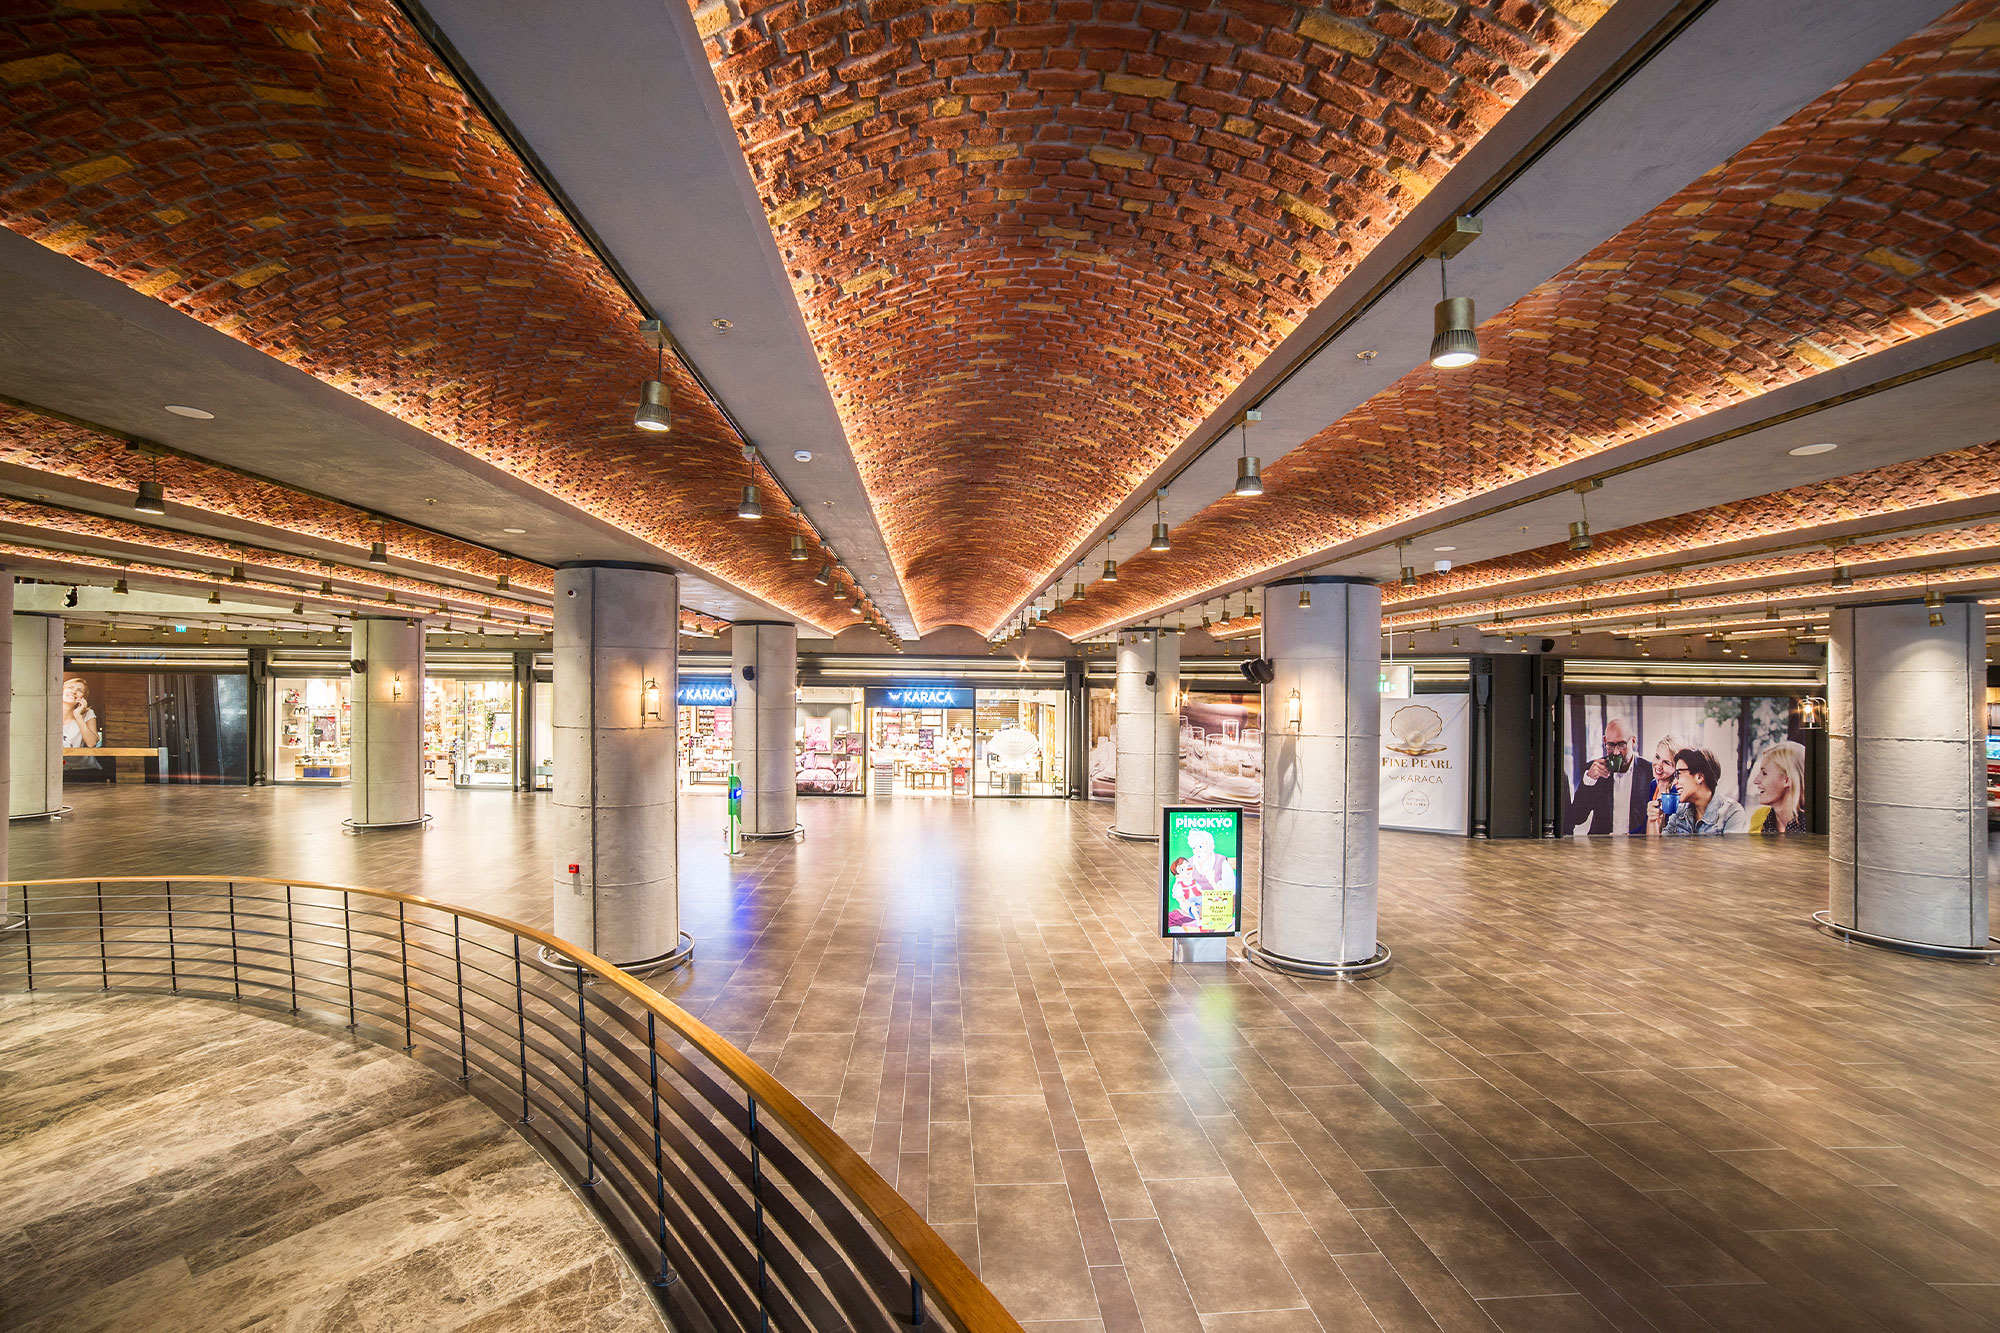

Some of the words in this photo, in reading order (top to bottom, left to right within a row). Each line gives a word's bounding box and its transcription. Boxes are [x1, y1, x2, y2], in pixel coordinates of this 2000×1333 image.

[903, 691, 954, 703] KARACA
[1382, 757, 1408, 767] FINE
[1411, 757, 1453, 769] PEARL
[1400, 774, 1444, 784] KARACA
